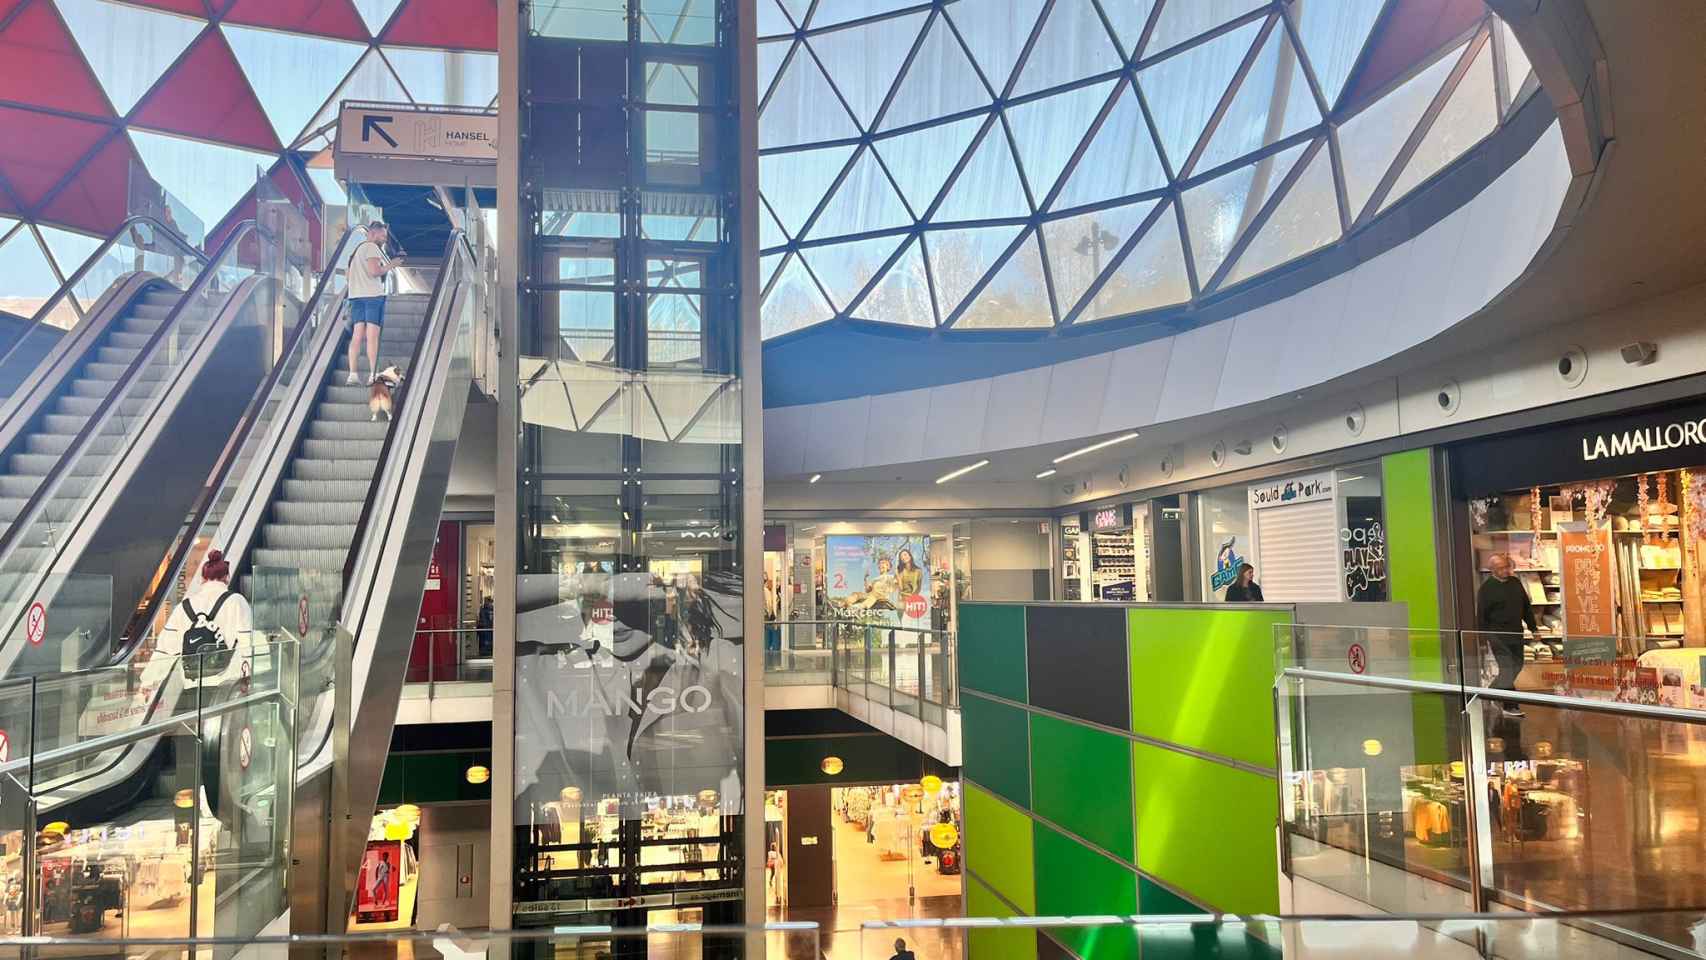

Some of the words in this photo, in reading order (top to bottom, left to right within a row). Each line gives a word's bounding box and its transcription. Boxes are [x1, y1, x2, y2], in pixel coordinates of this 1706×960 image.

[446, 131, 489, 141] HANSEL
[1583, 435, 1609, 461] LA
[592, 607, 614, 618] HIT!
[546, 685, 712, 719] MANGO
